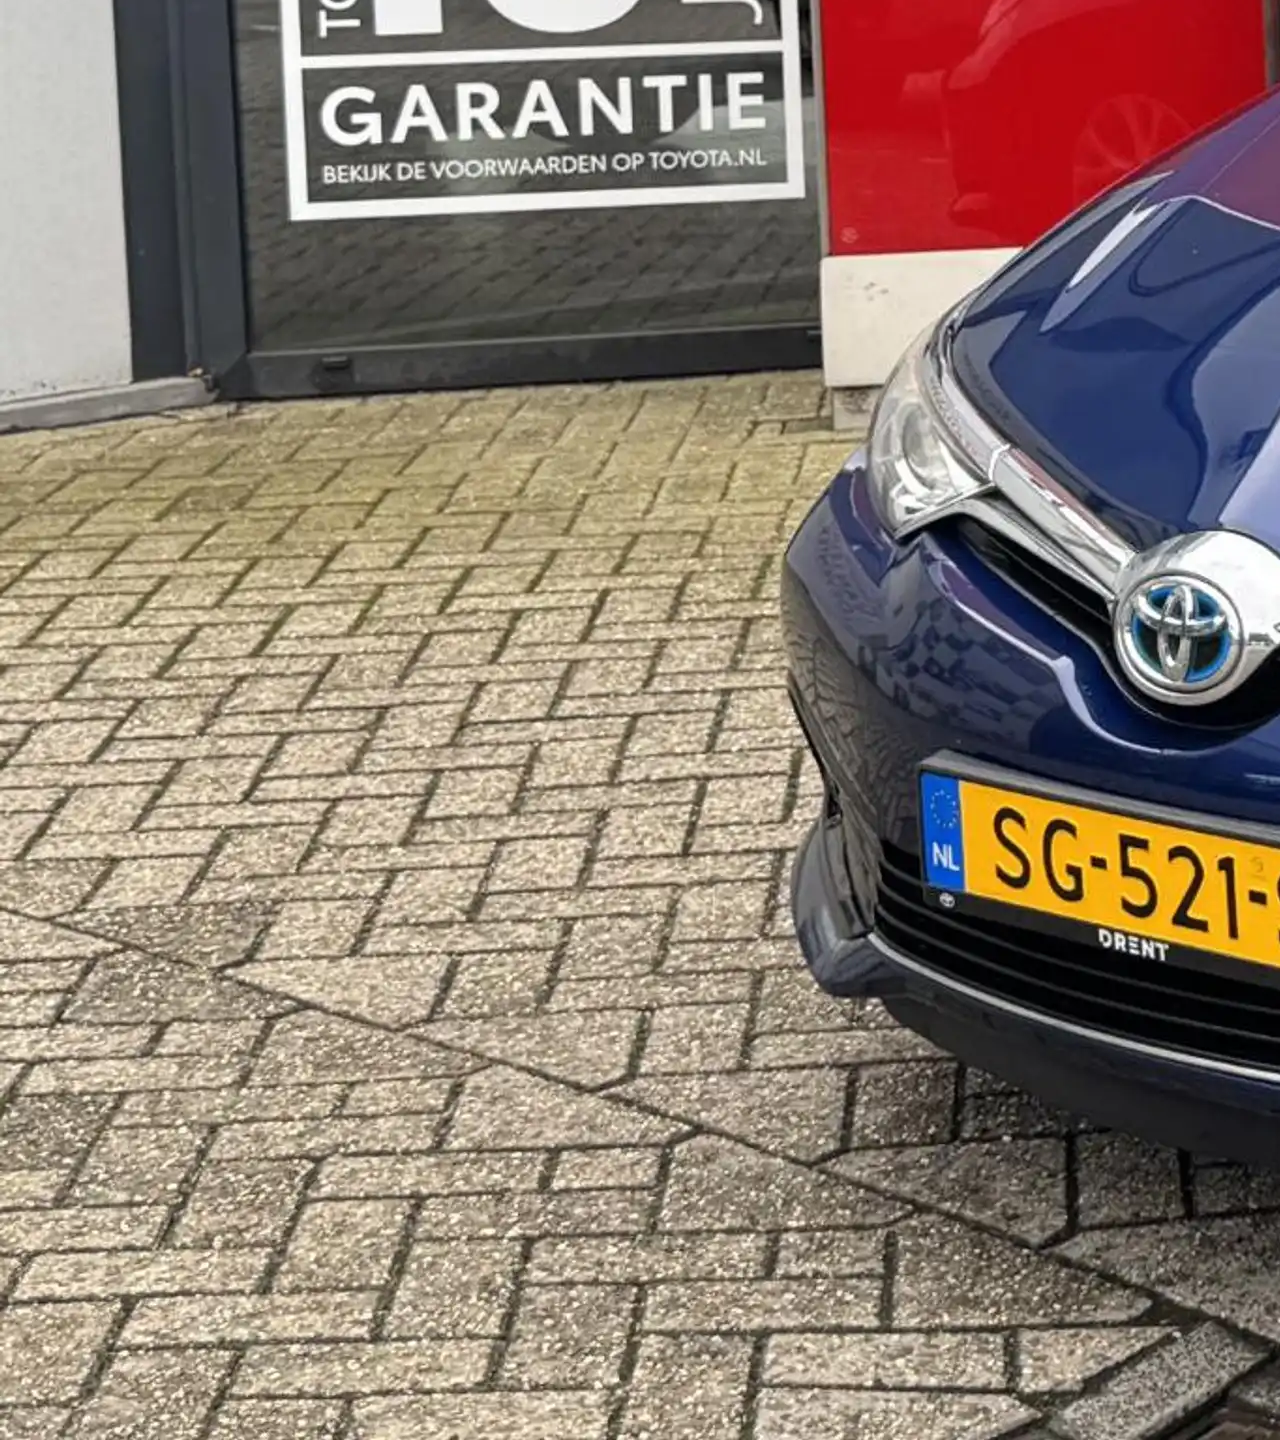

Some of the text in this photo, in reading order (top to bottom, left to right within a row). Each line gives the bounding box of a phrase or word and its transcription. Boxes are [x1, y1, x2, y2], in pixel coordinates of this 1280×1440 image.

[320, 71, 767, 146] GARANTIE
[322, 148, 767, 184] BEKIJK DE VOORWAARDEN OP TOYOTA.NL
[932, 841, 960, 872] NL
[1098, 927, 1169, 962] DRENT
